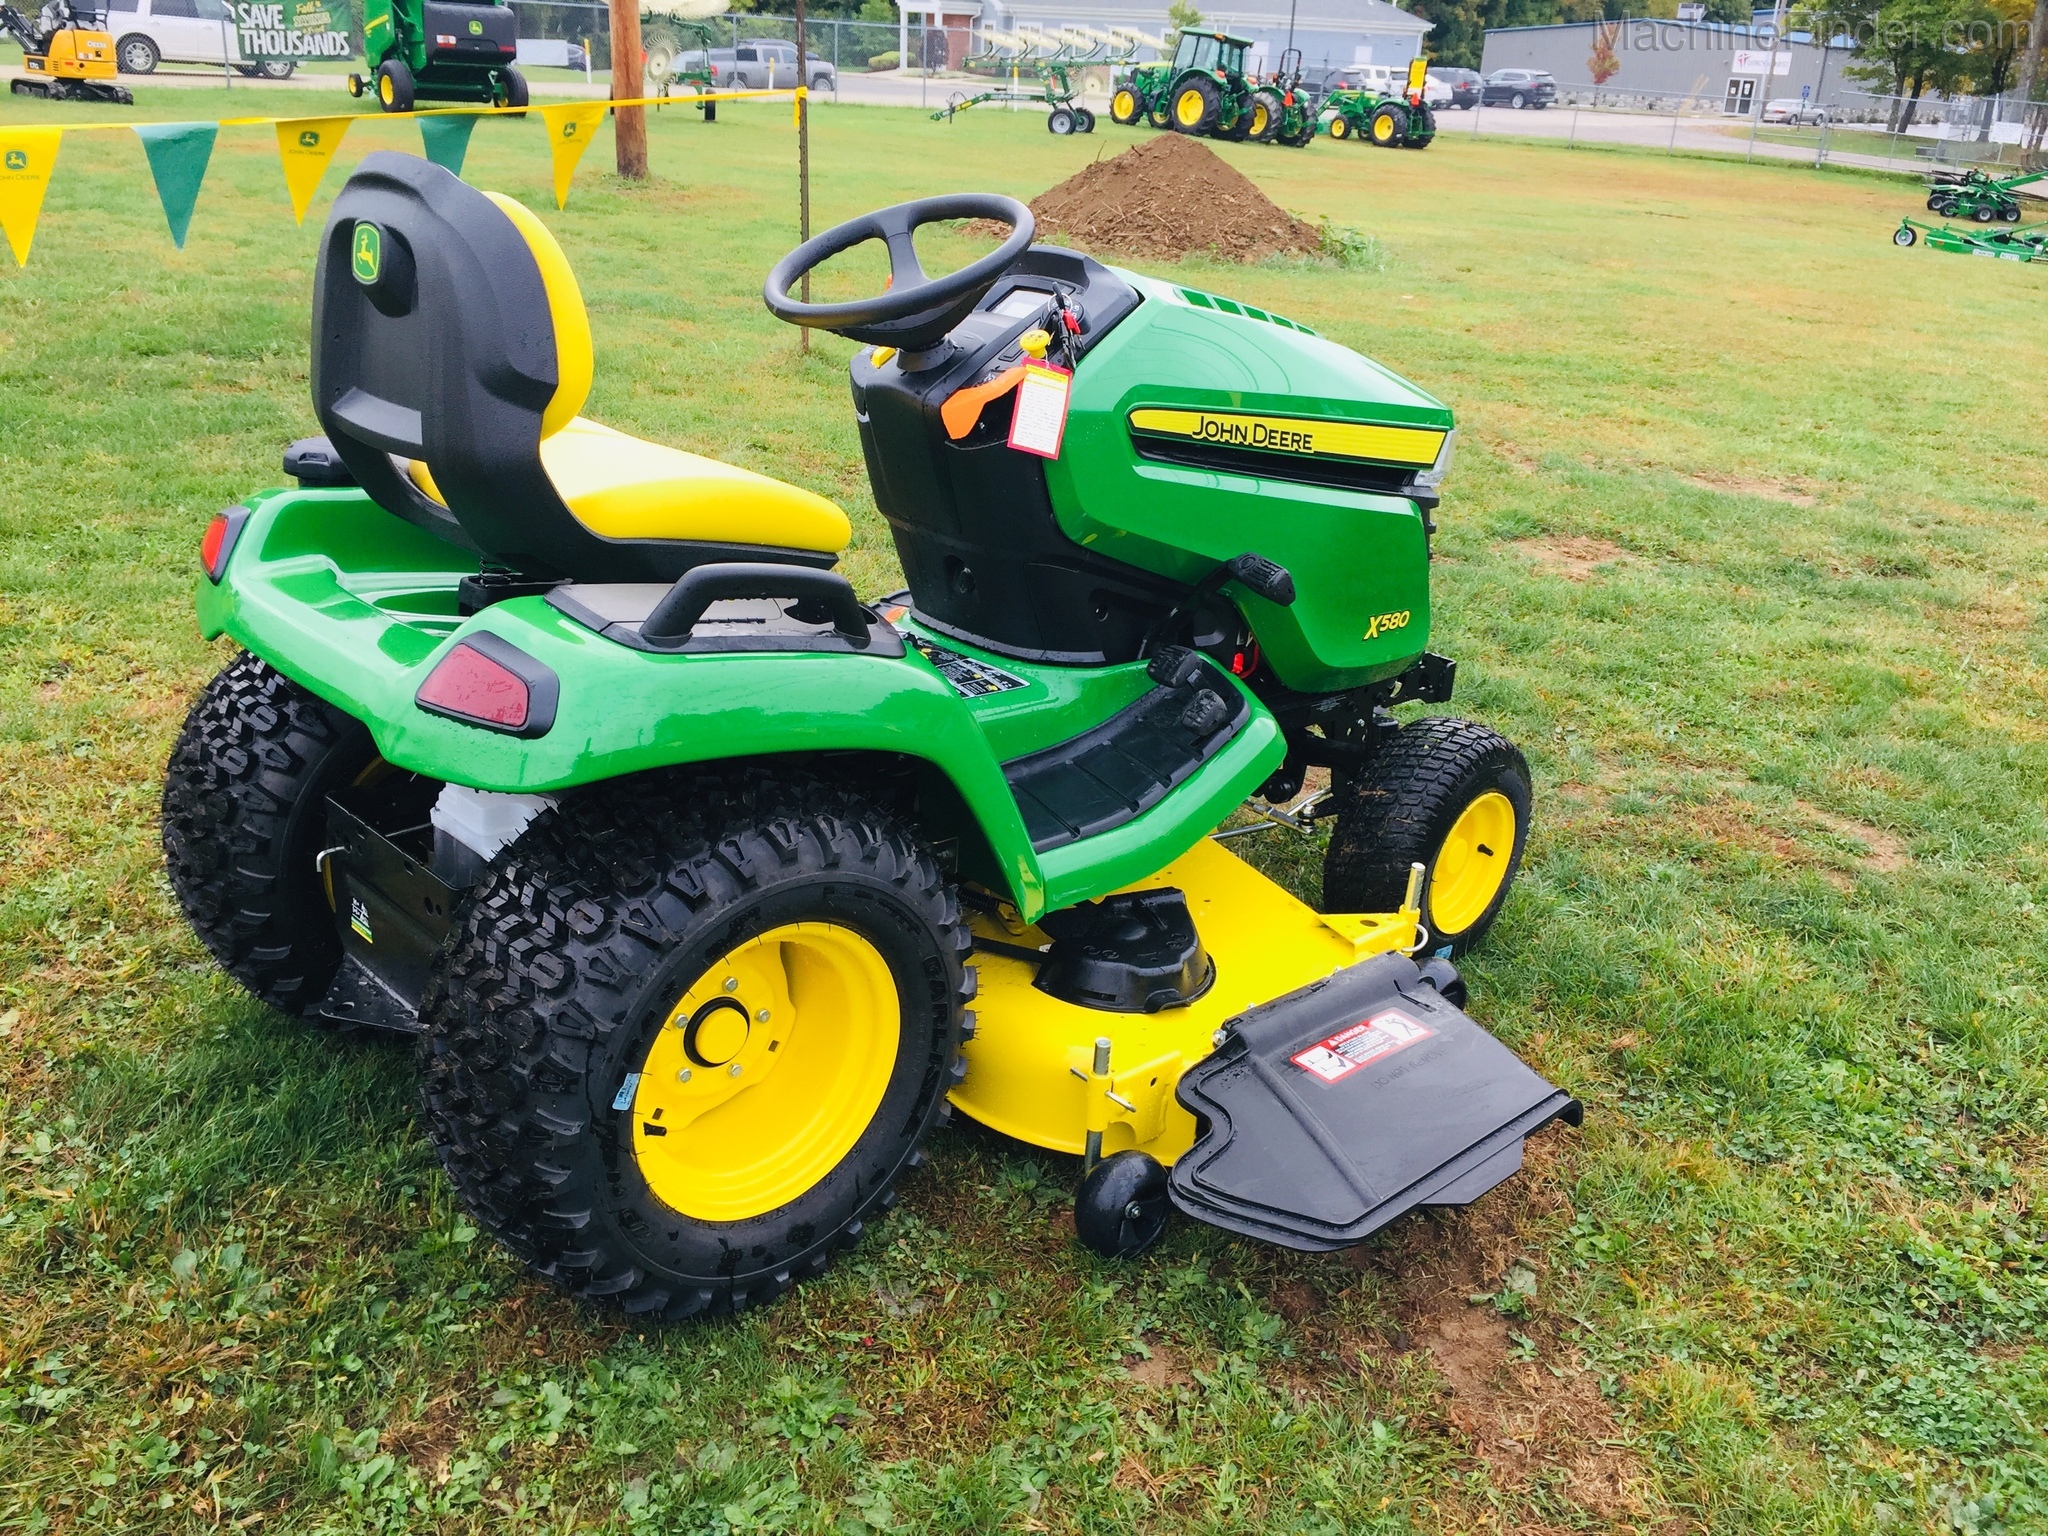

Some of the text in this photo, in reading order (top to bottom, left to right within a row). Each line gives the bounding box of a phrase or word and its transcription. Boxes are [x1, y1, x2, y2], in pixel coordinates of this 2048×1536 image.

[238, 3, 285, 29] SAVE
[240, 29, 350, 56] THOUSANDS
[1192, 415, 1313, 451] JOHN DEERE
[1362, 609, 1411, 641] X580
[1337, 1025, 1368, 1042] DANGER
